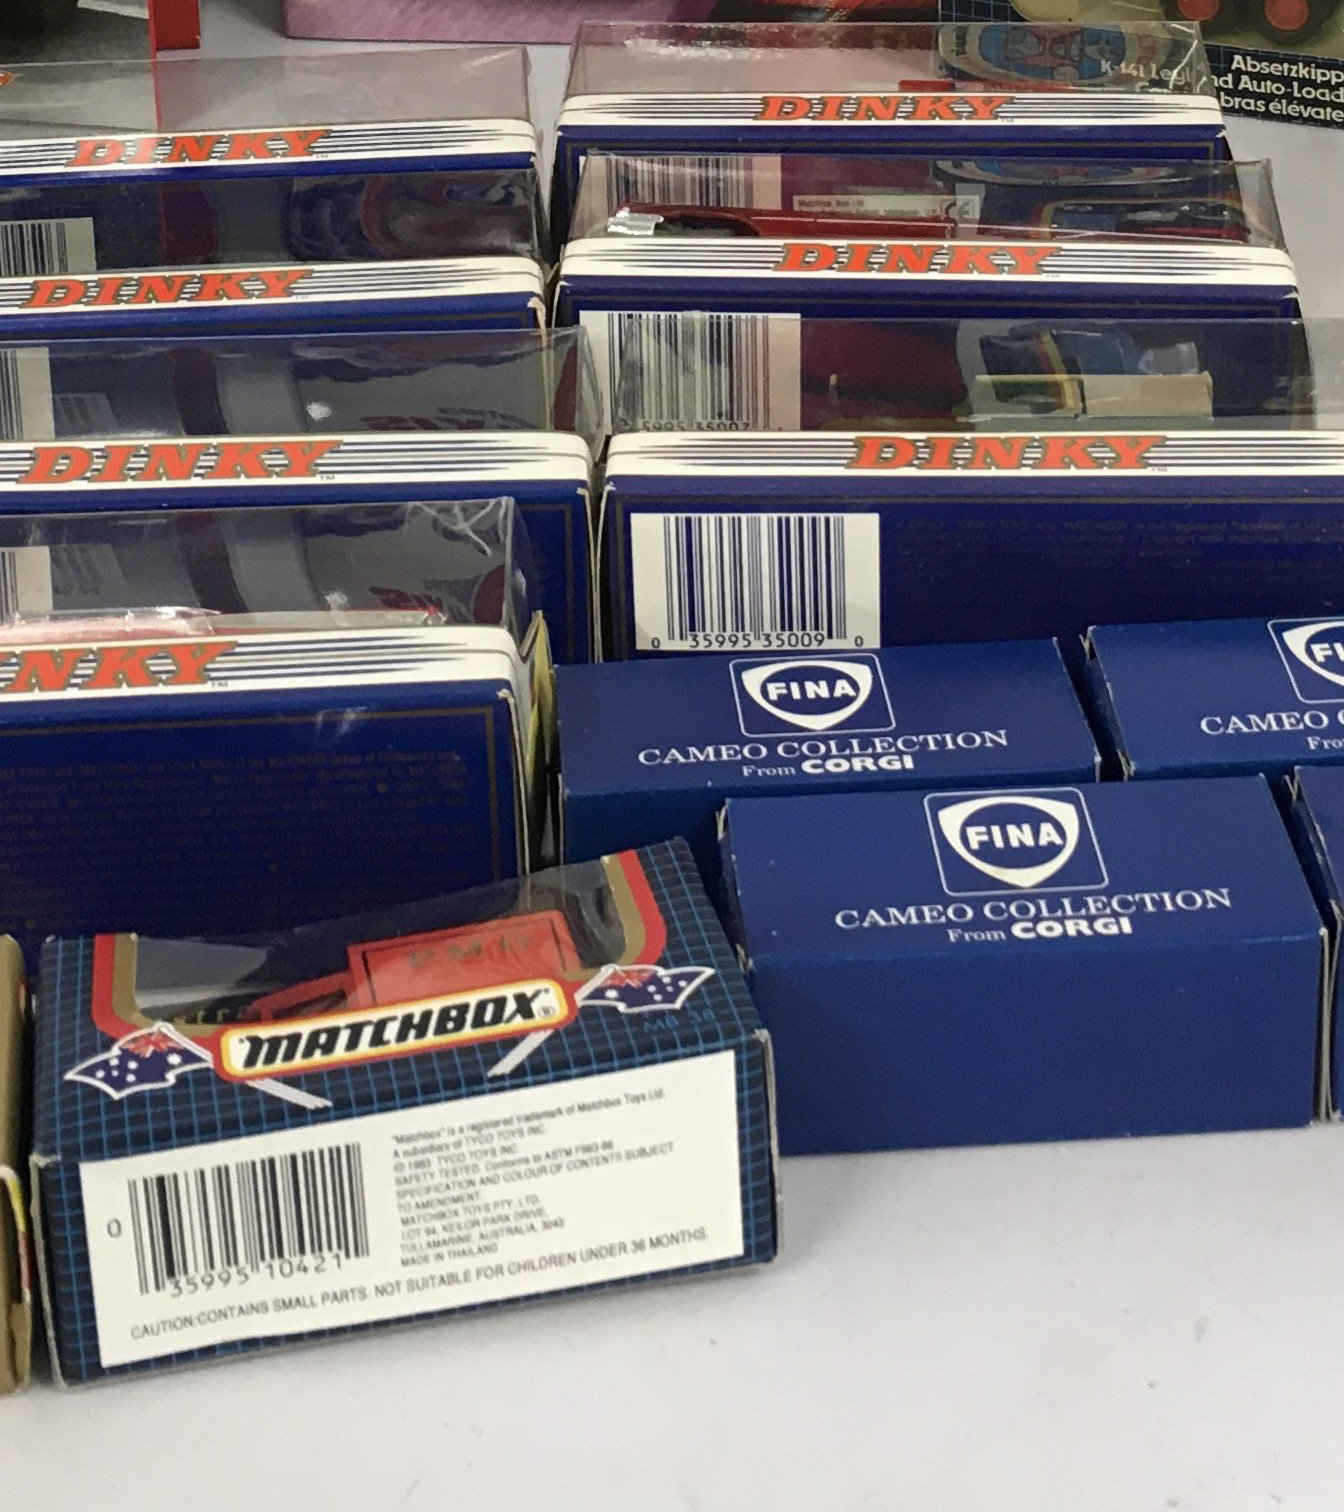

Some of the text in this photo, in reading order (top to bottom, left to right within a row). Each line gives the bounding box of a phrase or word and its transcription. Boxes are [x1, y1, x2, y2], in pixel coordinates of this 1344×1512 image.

[754, 94, 1016, 122] DINKY
[1221, 93, 1265, 113] bras
[64, 129, 332, 168] DINKY
[773, 242, 1063, 274] DINKY
[18, 269, 315, 309] DINKY
[15, 439, 345, 485] DINKY
[845, 435, 1169, 471] DINKY
[652, 631, 864, 648] 0 35995 35009 0
[767, 679, 855, 701] FINA
[1200, 711, 1328, 736] CAMEO
[638, 729, 1007, 765] CAMEO COLLECTION
[742, 755, 914, 777] From CORGI
[965, 823, 1063, 850] FINA
[835, 888, 1232, 929] CAMEO COLLECTION
[948, 918, 1132, 943] From CORGI
[107, 1218, 121, 1238] 0
[170, 1253, 343, 1298] 35995 10421
[273, 1294, 317, 1312] SMALL
[375, 1280, 402, 1297] NOT
[406, 1269, 472, 1293] SUITABLE
[476, 1263, 505, 1279] FOR
[507, 1252, 577, 1276] CHILDREN
[580, 1238, 629, 1262] UNDER
